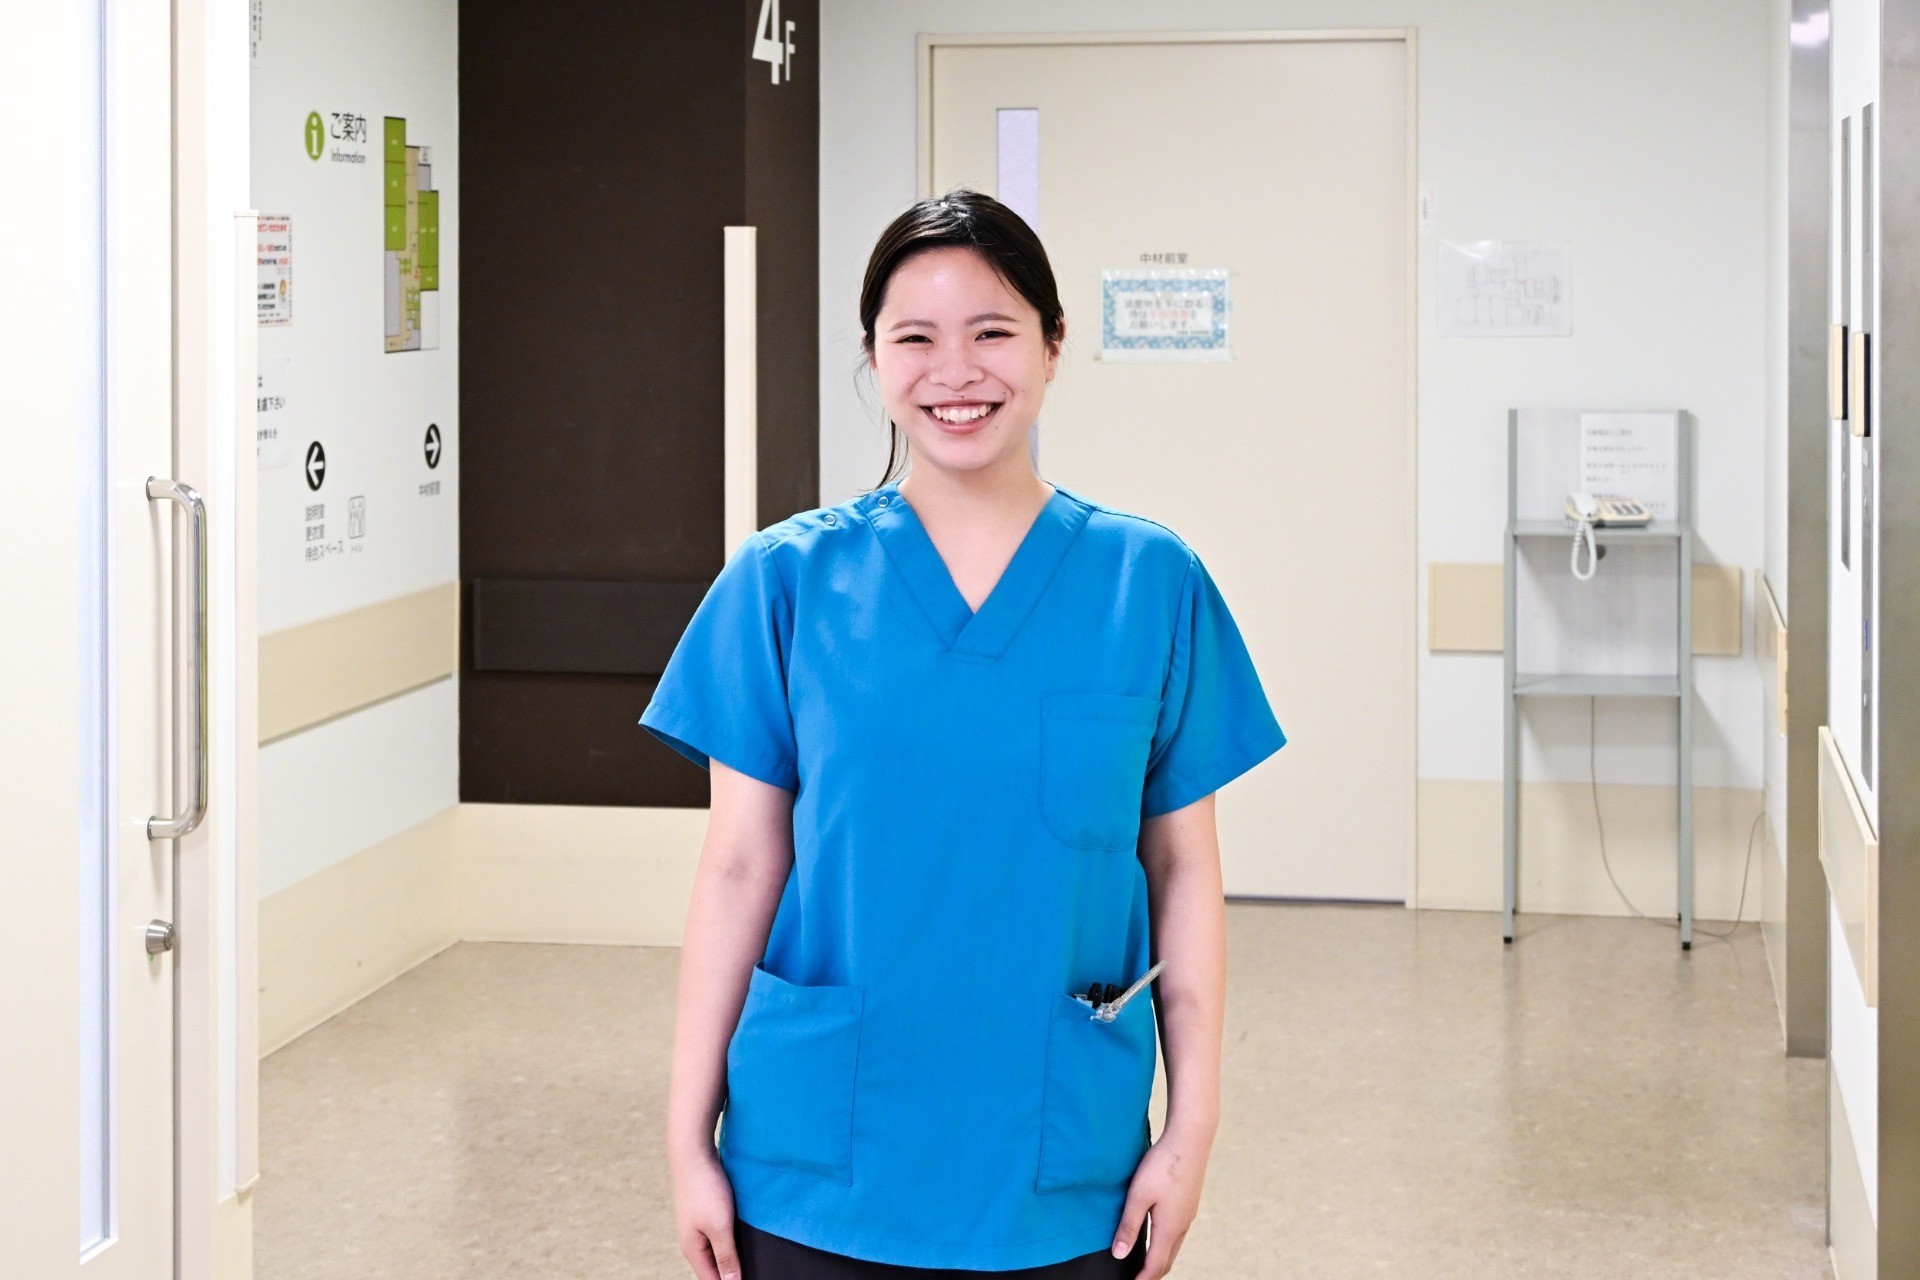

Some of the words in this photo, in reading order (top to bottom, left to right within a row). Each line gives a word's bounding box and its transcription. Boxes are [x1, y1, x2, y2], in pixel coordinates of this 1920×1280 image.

[752, 0, 796, 85] 4F
[330, 112, 367, 144] ご案内
[330, 148, 366, 164] Information
[1140, 252, 1188, 265] 中材前室
[305, 540, 343, 562] 待合スペース
